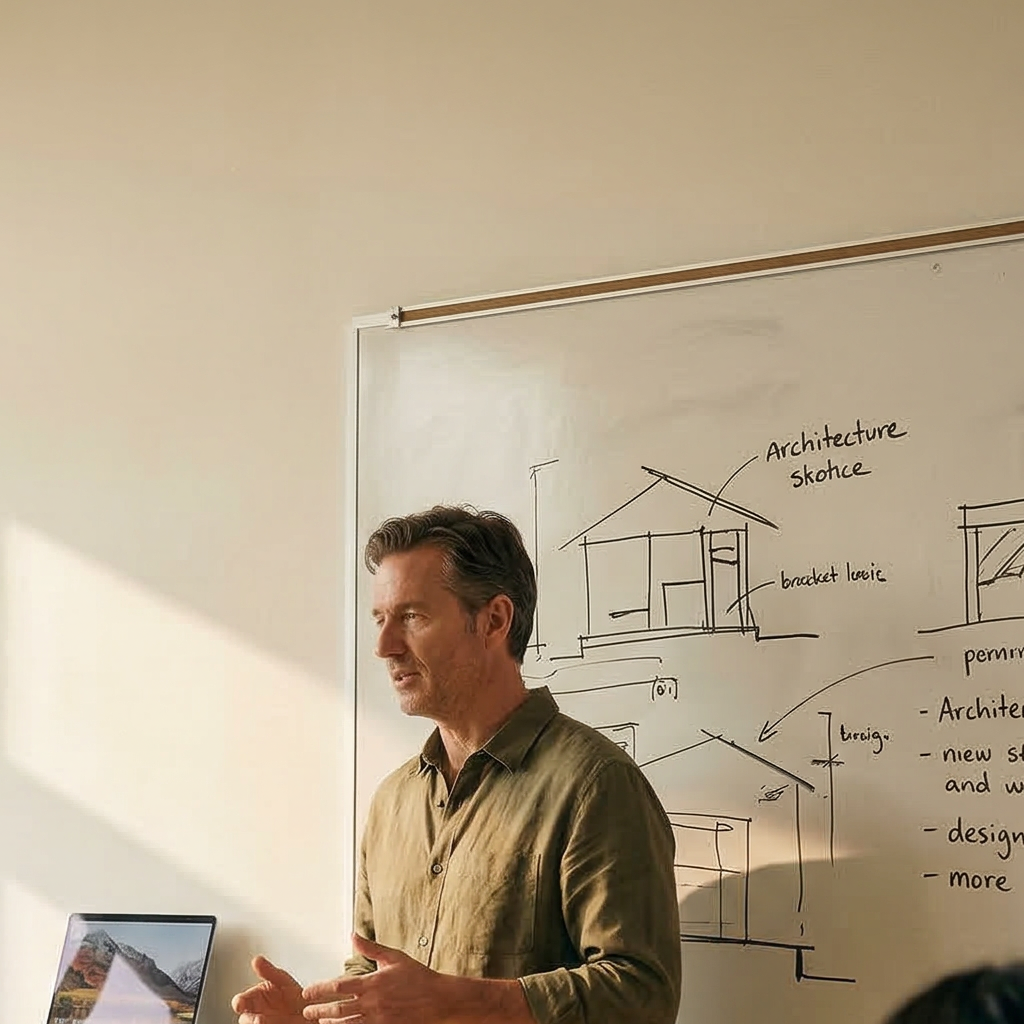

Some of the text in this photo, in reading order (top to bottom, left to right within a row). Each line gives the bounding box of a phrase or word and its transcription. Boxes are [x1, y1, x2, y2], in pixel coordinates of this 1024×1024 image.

[766, 419, 908, 462] Architecture
[938, 694, 1024, 723] Archite
[945, 771, 991, 793] and
[948, 816, 1024, 860] design
[949, 871, 1012, 892] more
